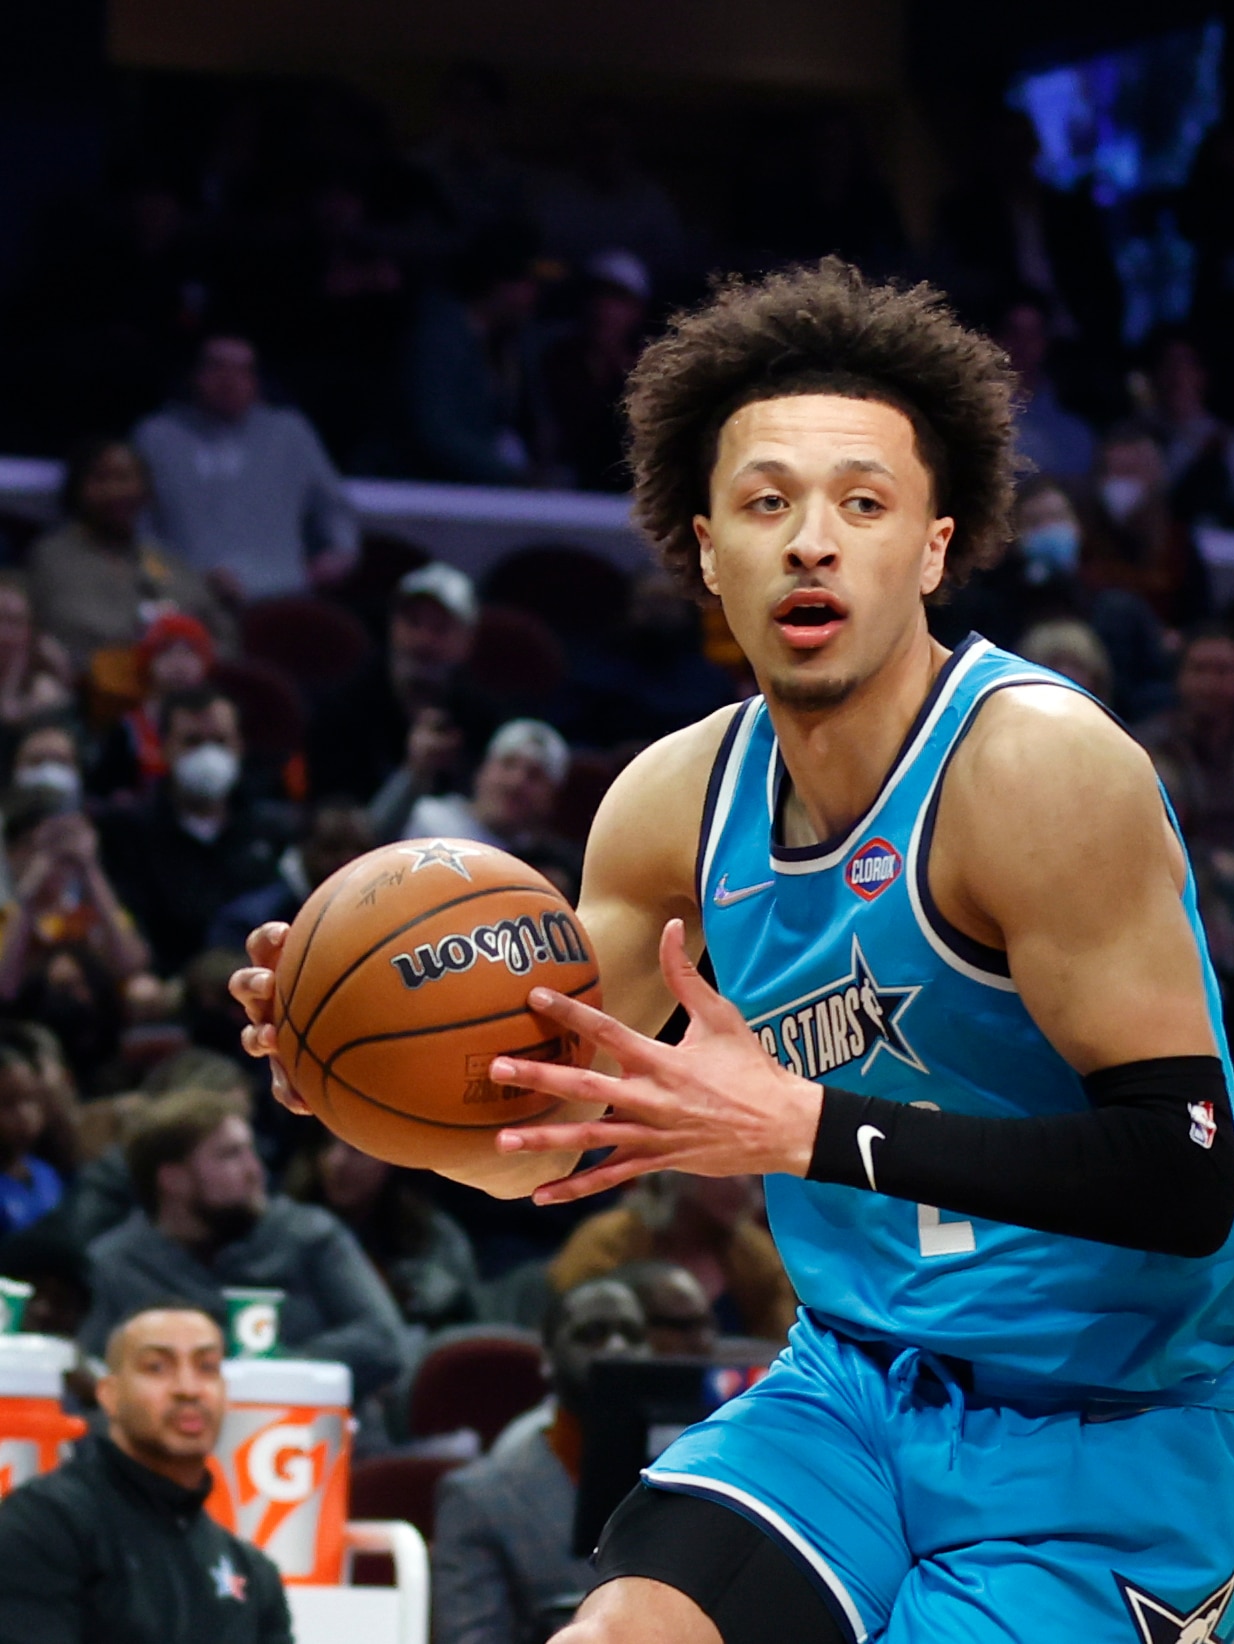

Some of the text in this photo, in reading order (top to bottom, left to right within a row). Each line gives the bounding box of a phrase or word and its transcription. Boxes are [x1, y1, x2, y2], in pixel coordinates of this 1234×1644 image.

[851, 854, 896, 885] CLOROX
[390, 910, 590, 990] Wilson
[781, 985, 866, 1079] STARS
[247, 1424, 315, 1502] G
